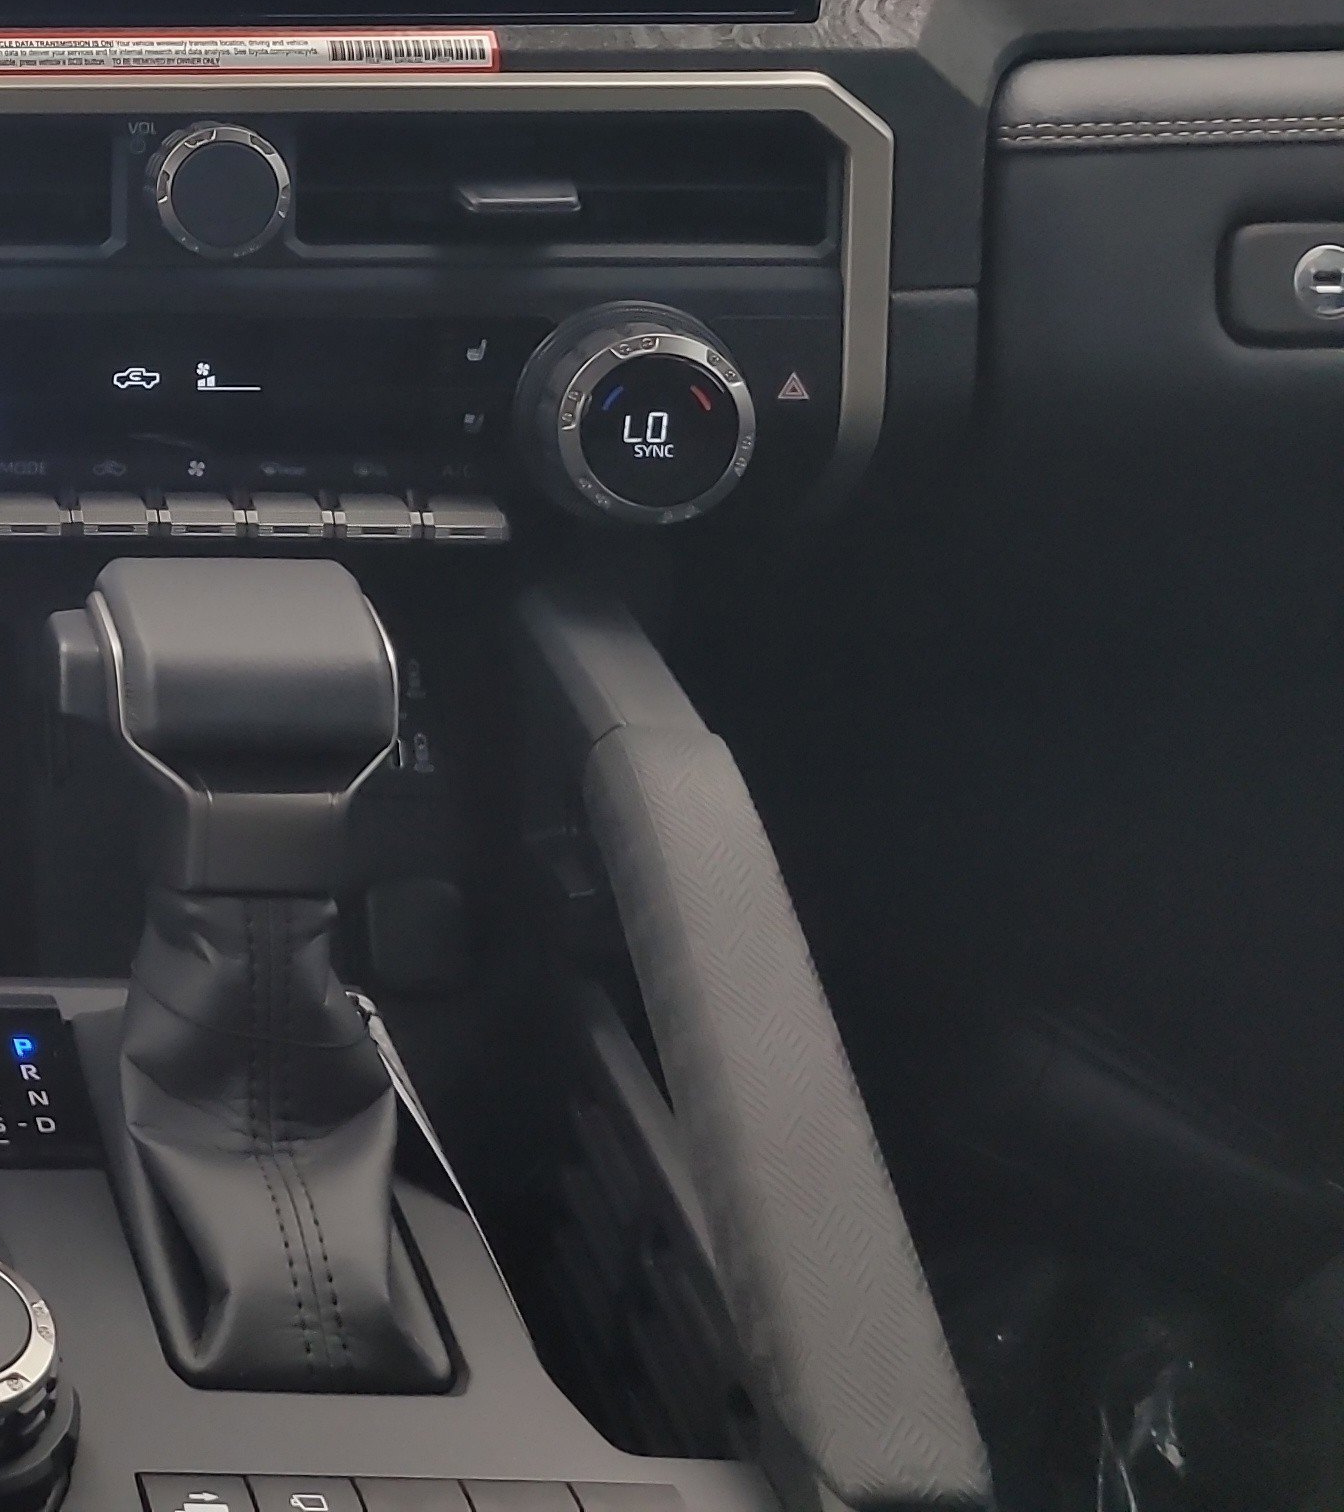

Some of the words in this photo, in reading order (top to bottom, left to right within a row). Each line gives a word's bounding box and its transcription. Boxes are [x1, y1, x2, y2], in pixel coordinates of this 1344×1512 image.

[15, 40, 34, 48] DATA
[35, 40, 90, 48] TRANSMISSION
[112, 57, 121, 65] TO
[128, 121, 157, 135] VOL
[622, 411, 669, 444] LO
[634, 443, 674, 459] SYNC
[13, 1038, 32, 1056] P
[19, 1064, 41, 1081] R
[28, 1090, 50, 1106] N
[36, 1117, 56, 1133] D
